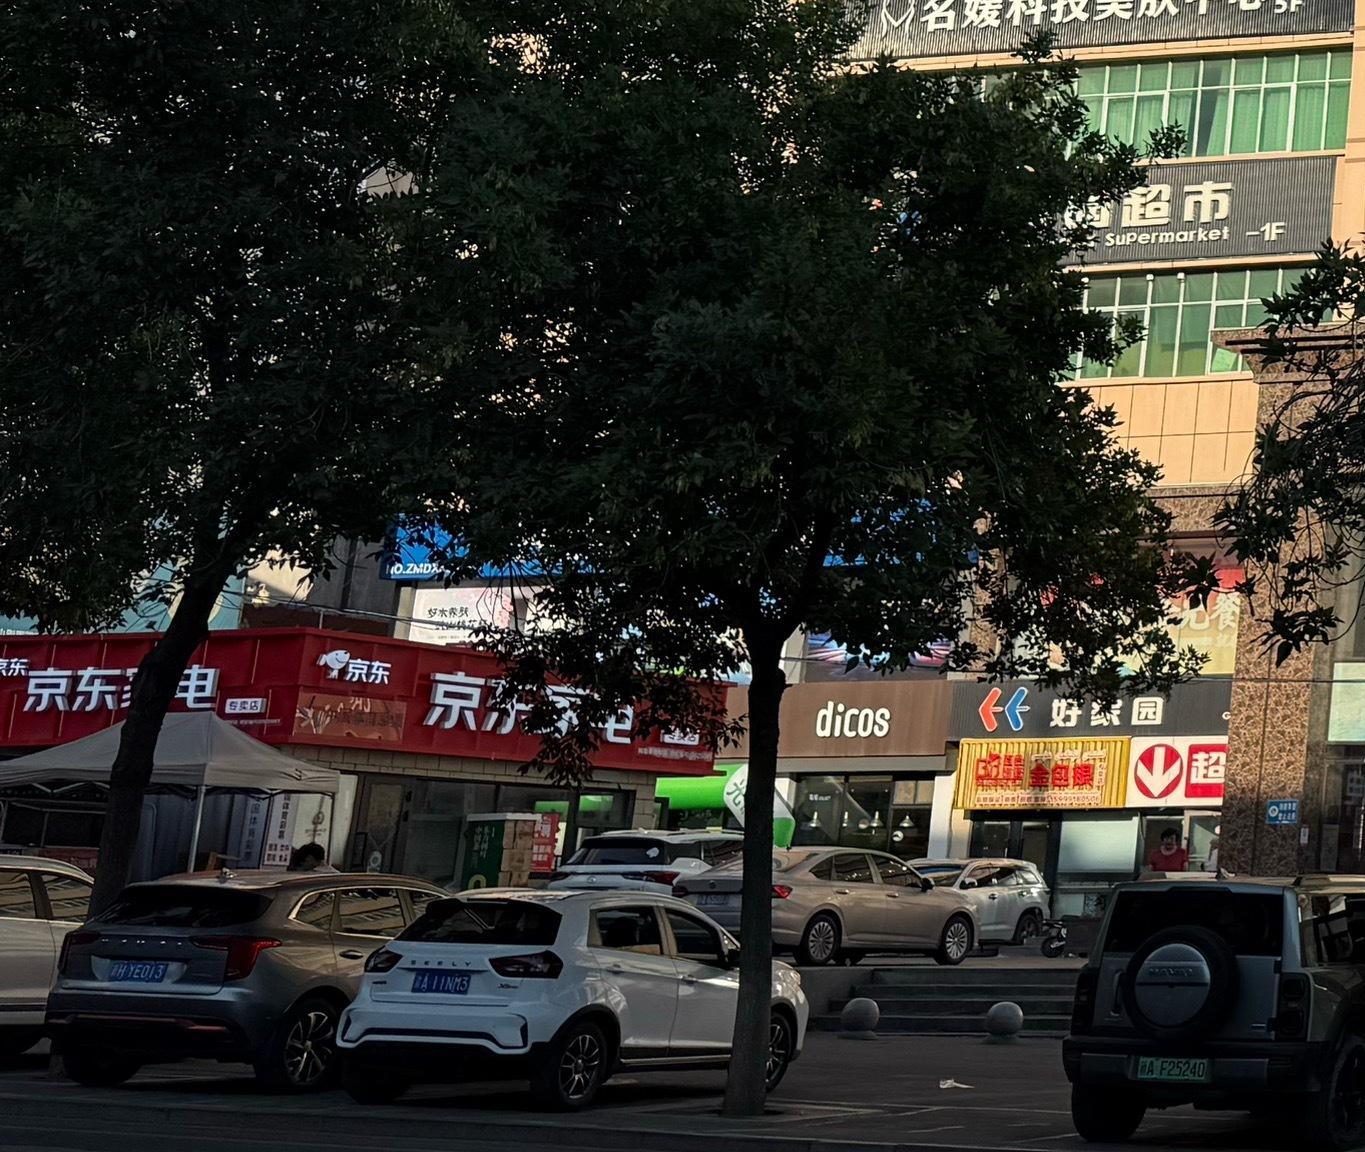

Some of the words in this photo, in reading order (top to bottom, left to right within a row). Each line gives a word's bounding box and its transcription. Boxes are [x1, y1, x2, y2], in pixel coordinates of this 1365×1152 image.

[1105, 226, 1230, 247] Supermarket
[345, 658, 391, 685] 京东
[23, 665, 219, 712] 京东电
[228, 700, 260, 711] 专卖店
[815, 700, 890, 738] dicos
[1049, 696, 1164, 728] 好家园
